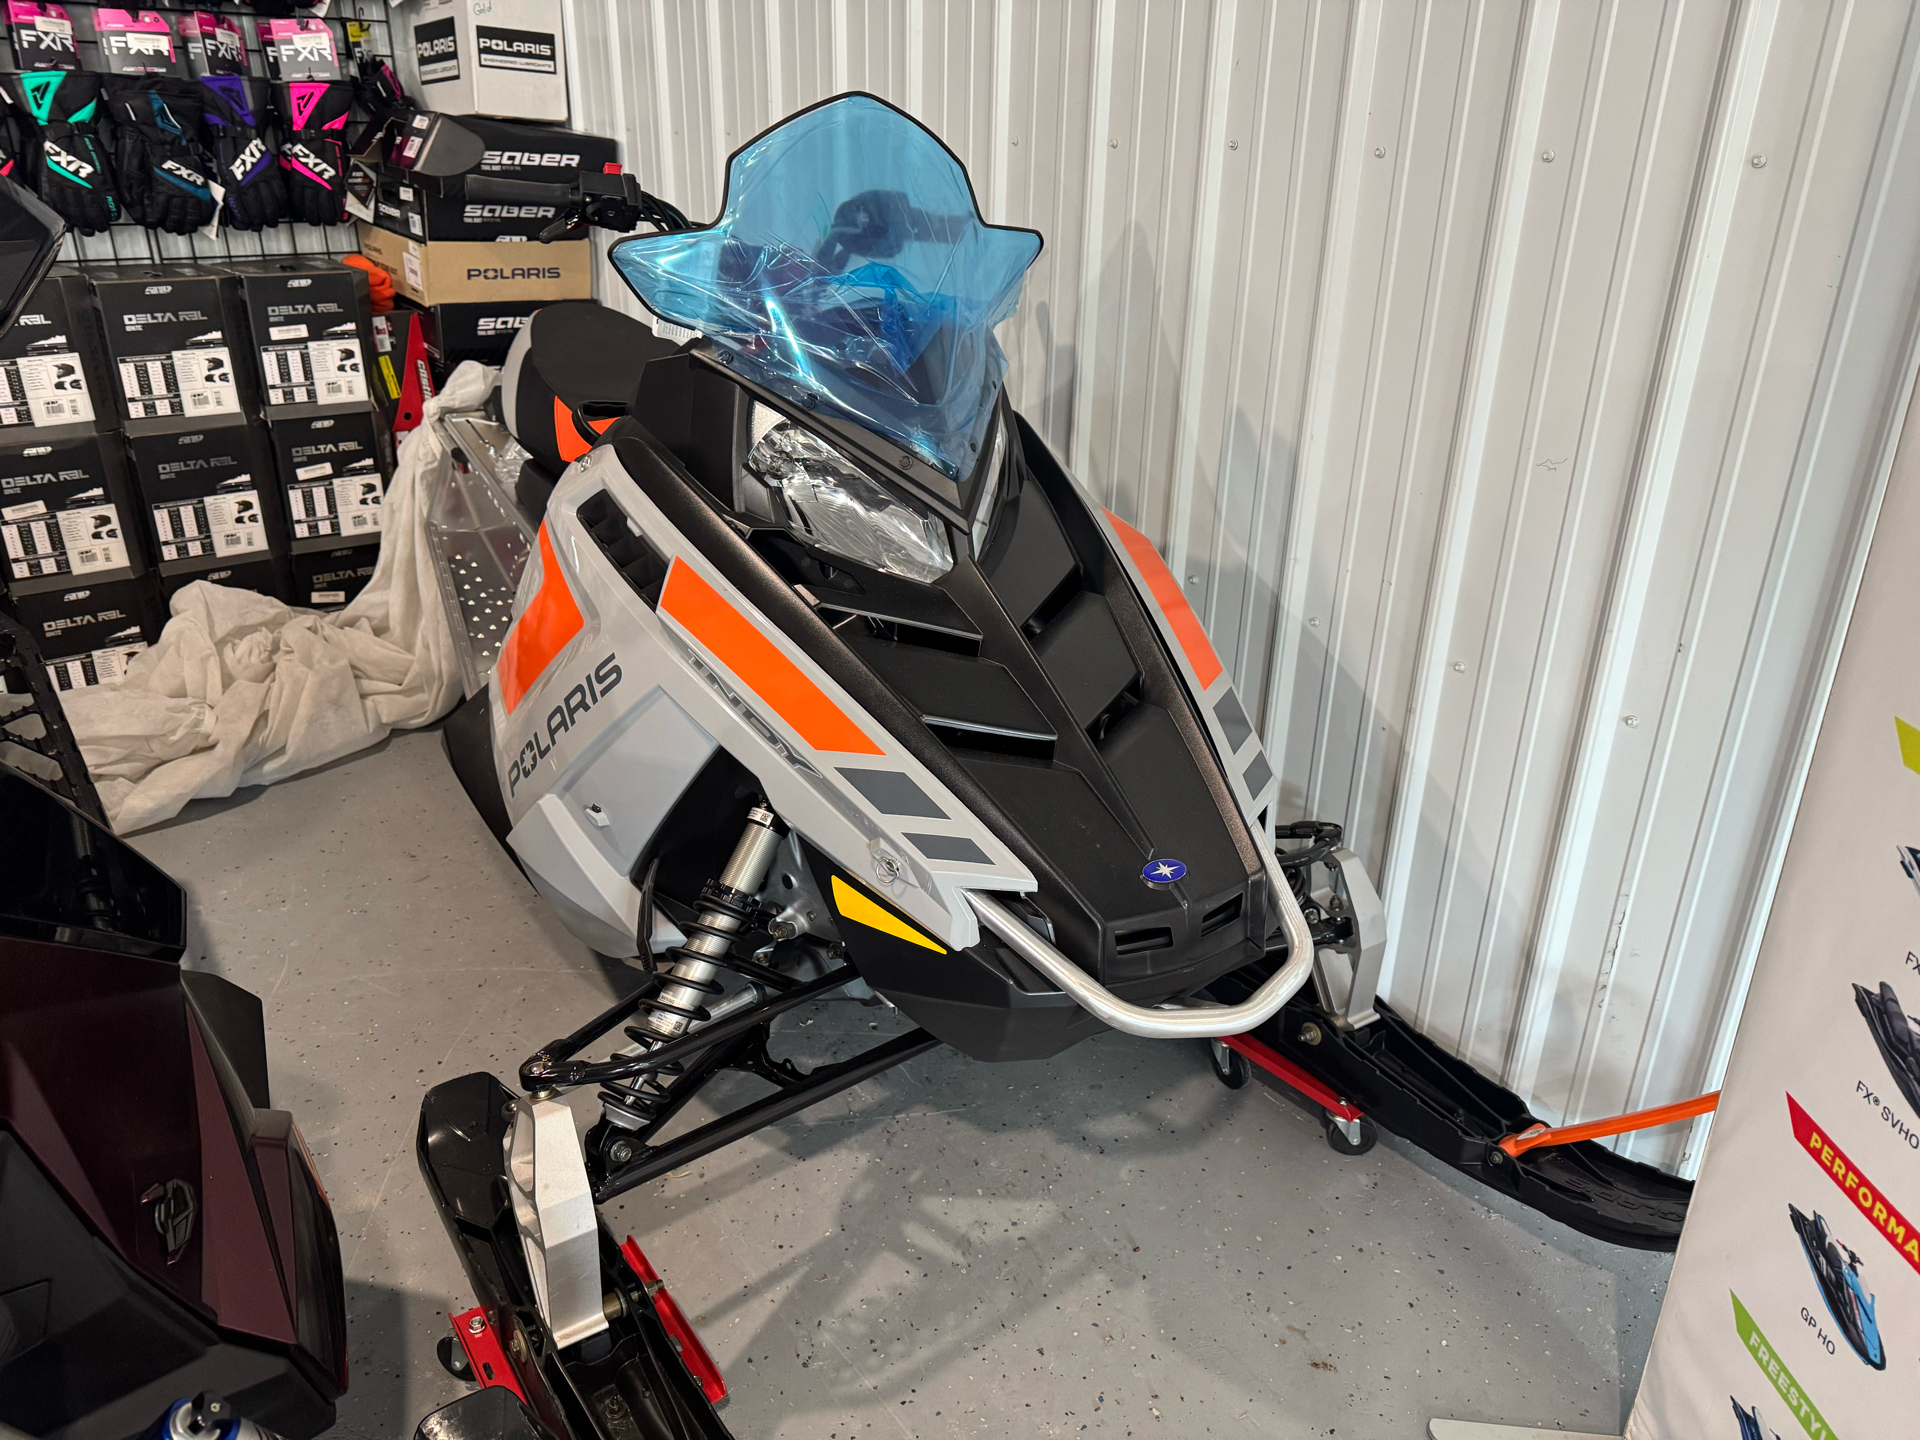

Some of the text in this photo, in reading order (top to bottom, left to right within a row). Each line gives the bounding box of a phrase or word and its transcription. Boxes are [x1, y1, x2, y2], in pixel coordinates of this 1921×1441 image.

[473, 1, 492, 15] Gold
[19, 29, 75, 52] FXR
[204, 38, 239, 62] FXR
[417, 36, 455, 58] POLARIS
[478, 37, 552, 56] POLARIS
[279, 45, 333, 62] FXR
[44, 140, 94, 178] FXR
[229, 137, 267, 181] FXR
[291, 143, 336, 180] FXR
[161, 159, 206, 186] FXR
[466, 267, 561, 281] POLARIS
[122, 312, 177, 325] DELTA
[267, 304, 316, 316] DELTA
[476, 315, 530, 330] SAB
[291, 443, 337, 457] DELTA
[158, 459, 209, 474] DELTA
[0, 473, 58, 489] DELTA
[312, 569, 355, 584] DELTA
[42, 614, 96, 632] DELTA
[688, 648, 823, 779] INDY
[507, 652, 623, 798] POLARIS
[1881, 1106, 1919, 1150] SVHO
[1565, 1176, 1685, 1223] OLARIS
[1809, 1131, 1919, 1263] PERFORMA
[1800, 1307, 1836, 1355] GP HO
